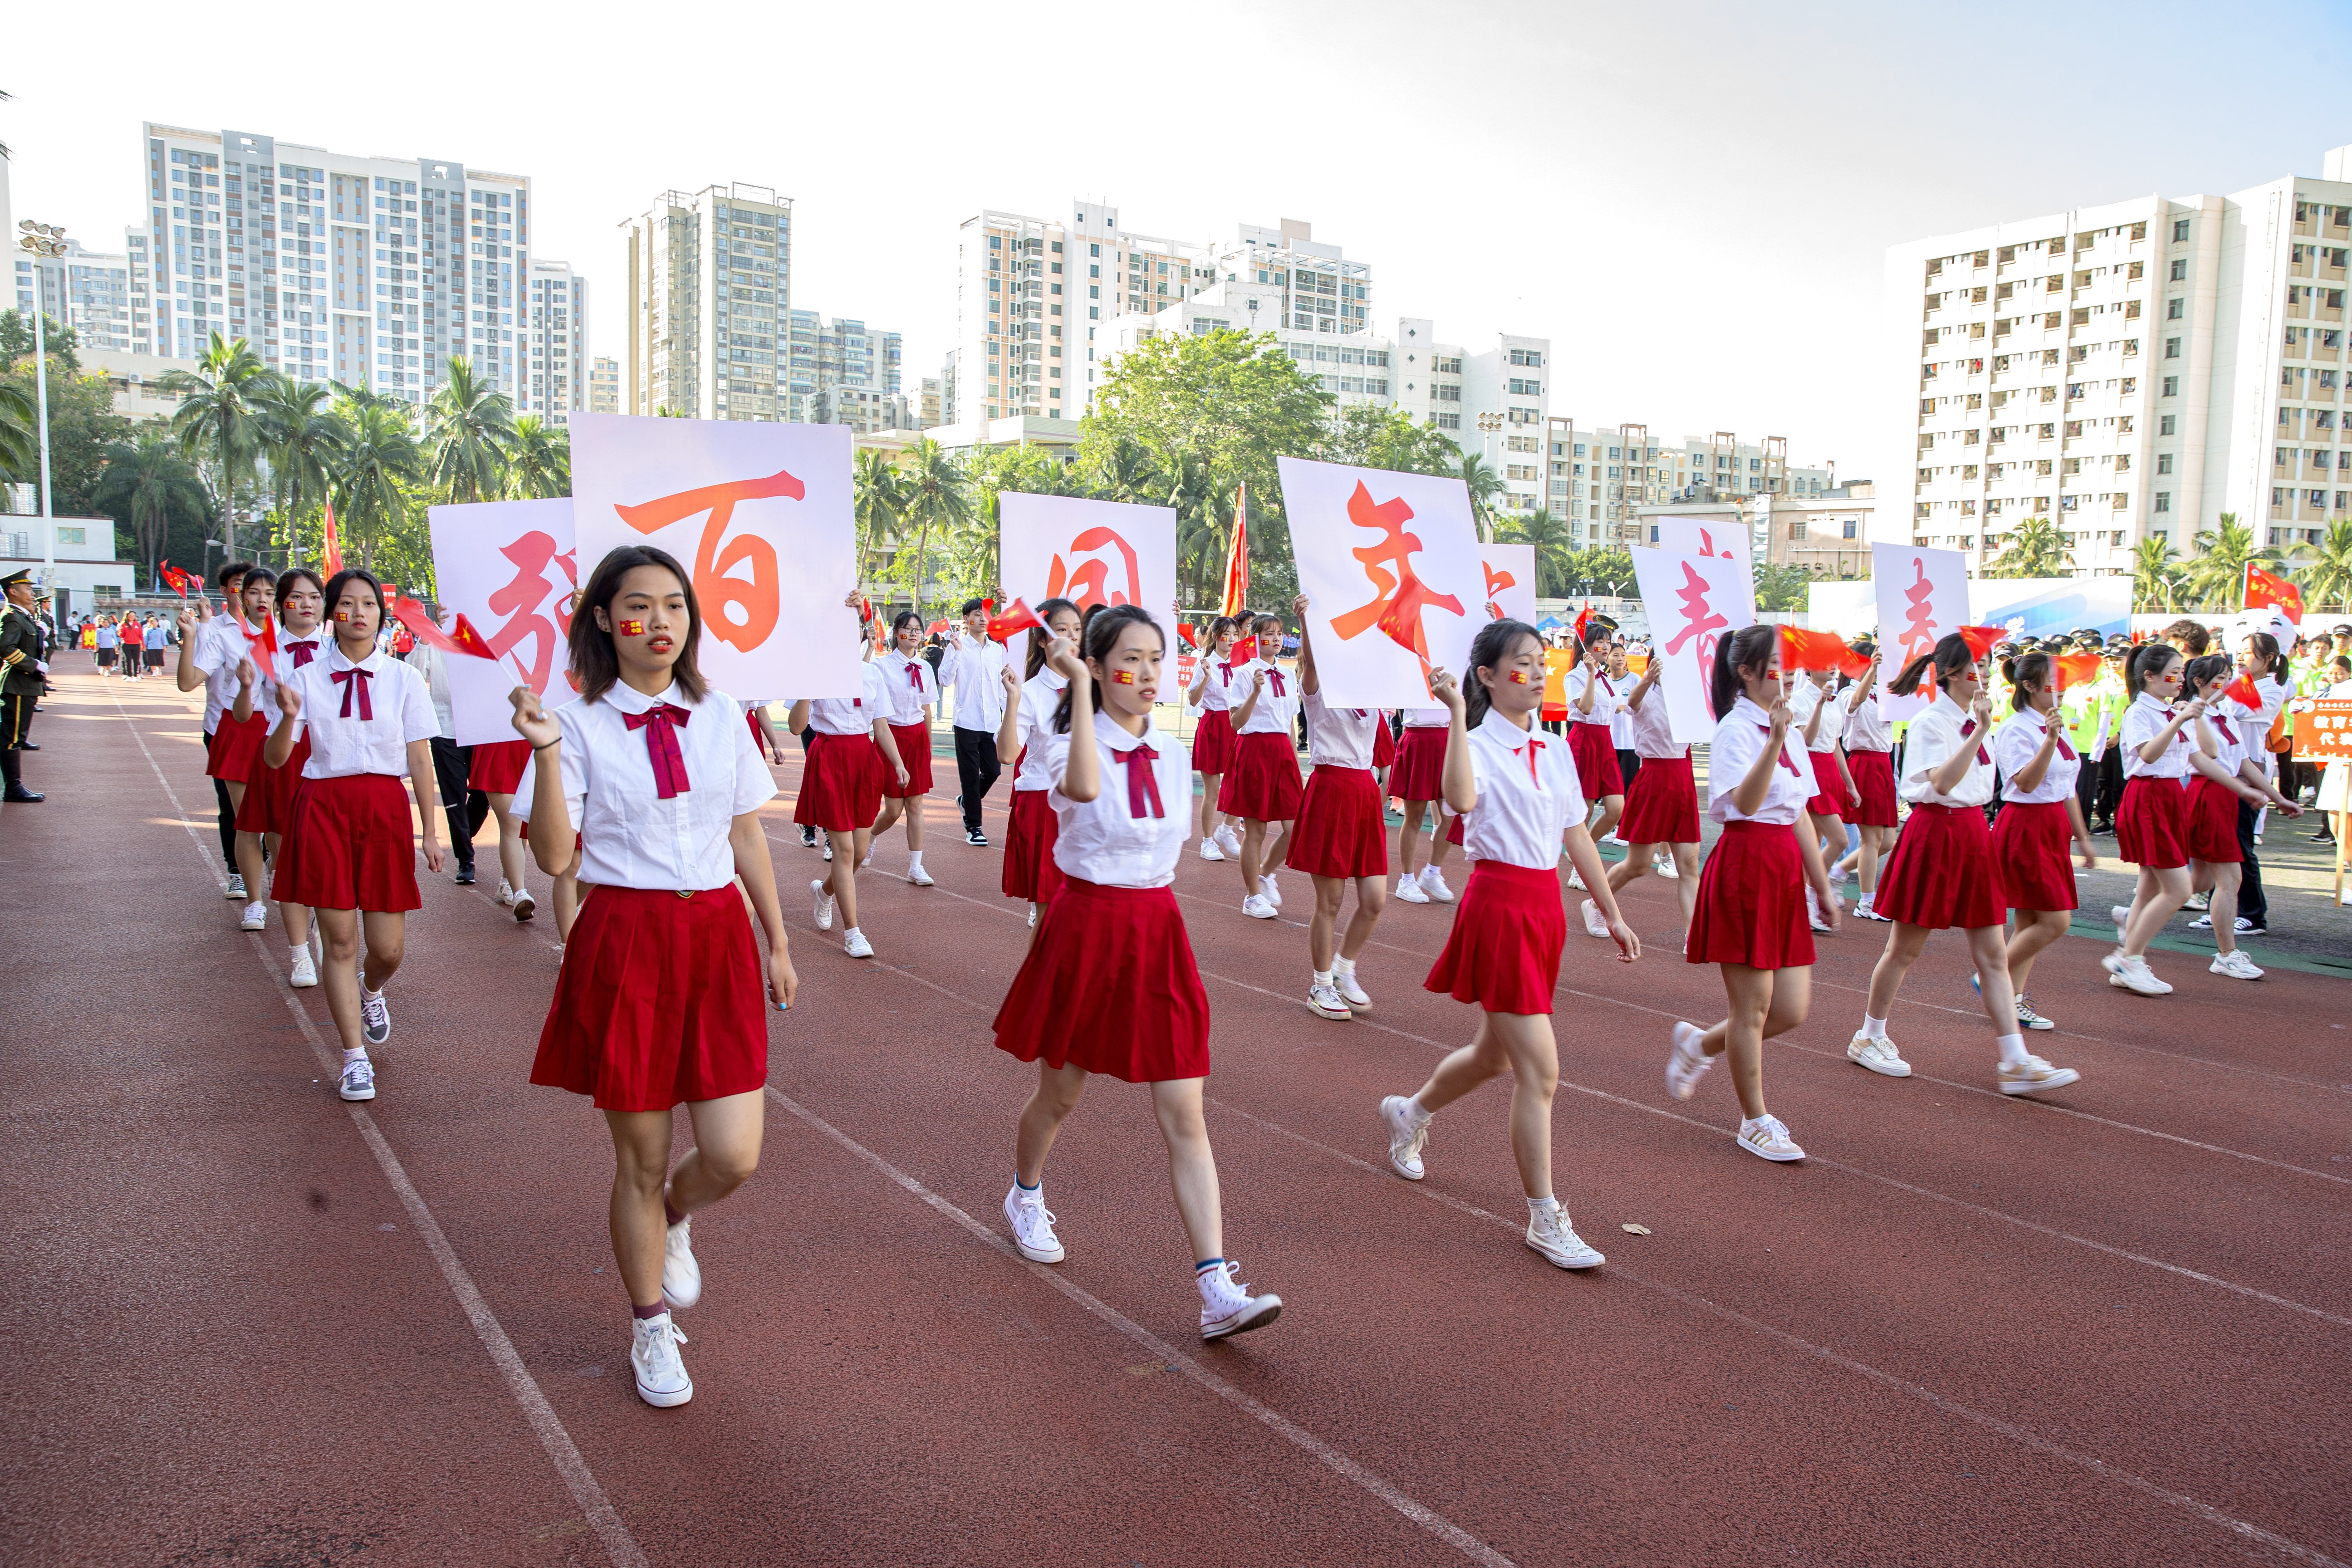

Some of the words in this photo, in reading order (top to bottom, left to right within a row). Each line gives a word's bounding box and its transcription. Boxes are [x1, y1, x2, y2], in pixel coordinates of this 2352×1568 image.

[614, 470, 805, 653] 百
[1329, 478, 1465, 702] 年
[1665, 559, 1729, 721] 青
[1886, 557, 1937, 703] 春
[2313, 715, 2352, 729] 教育
